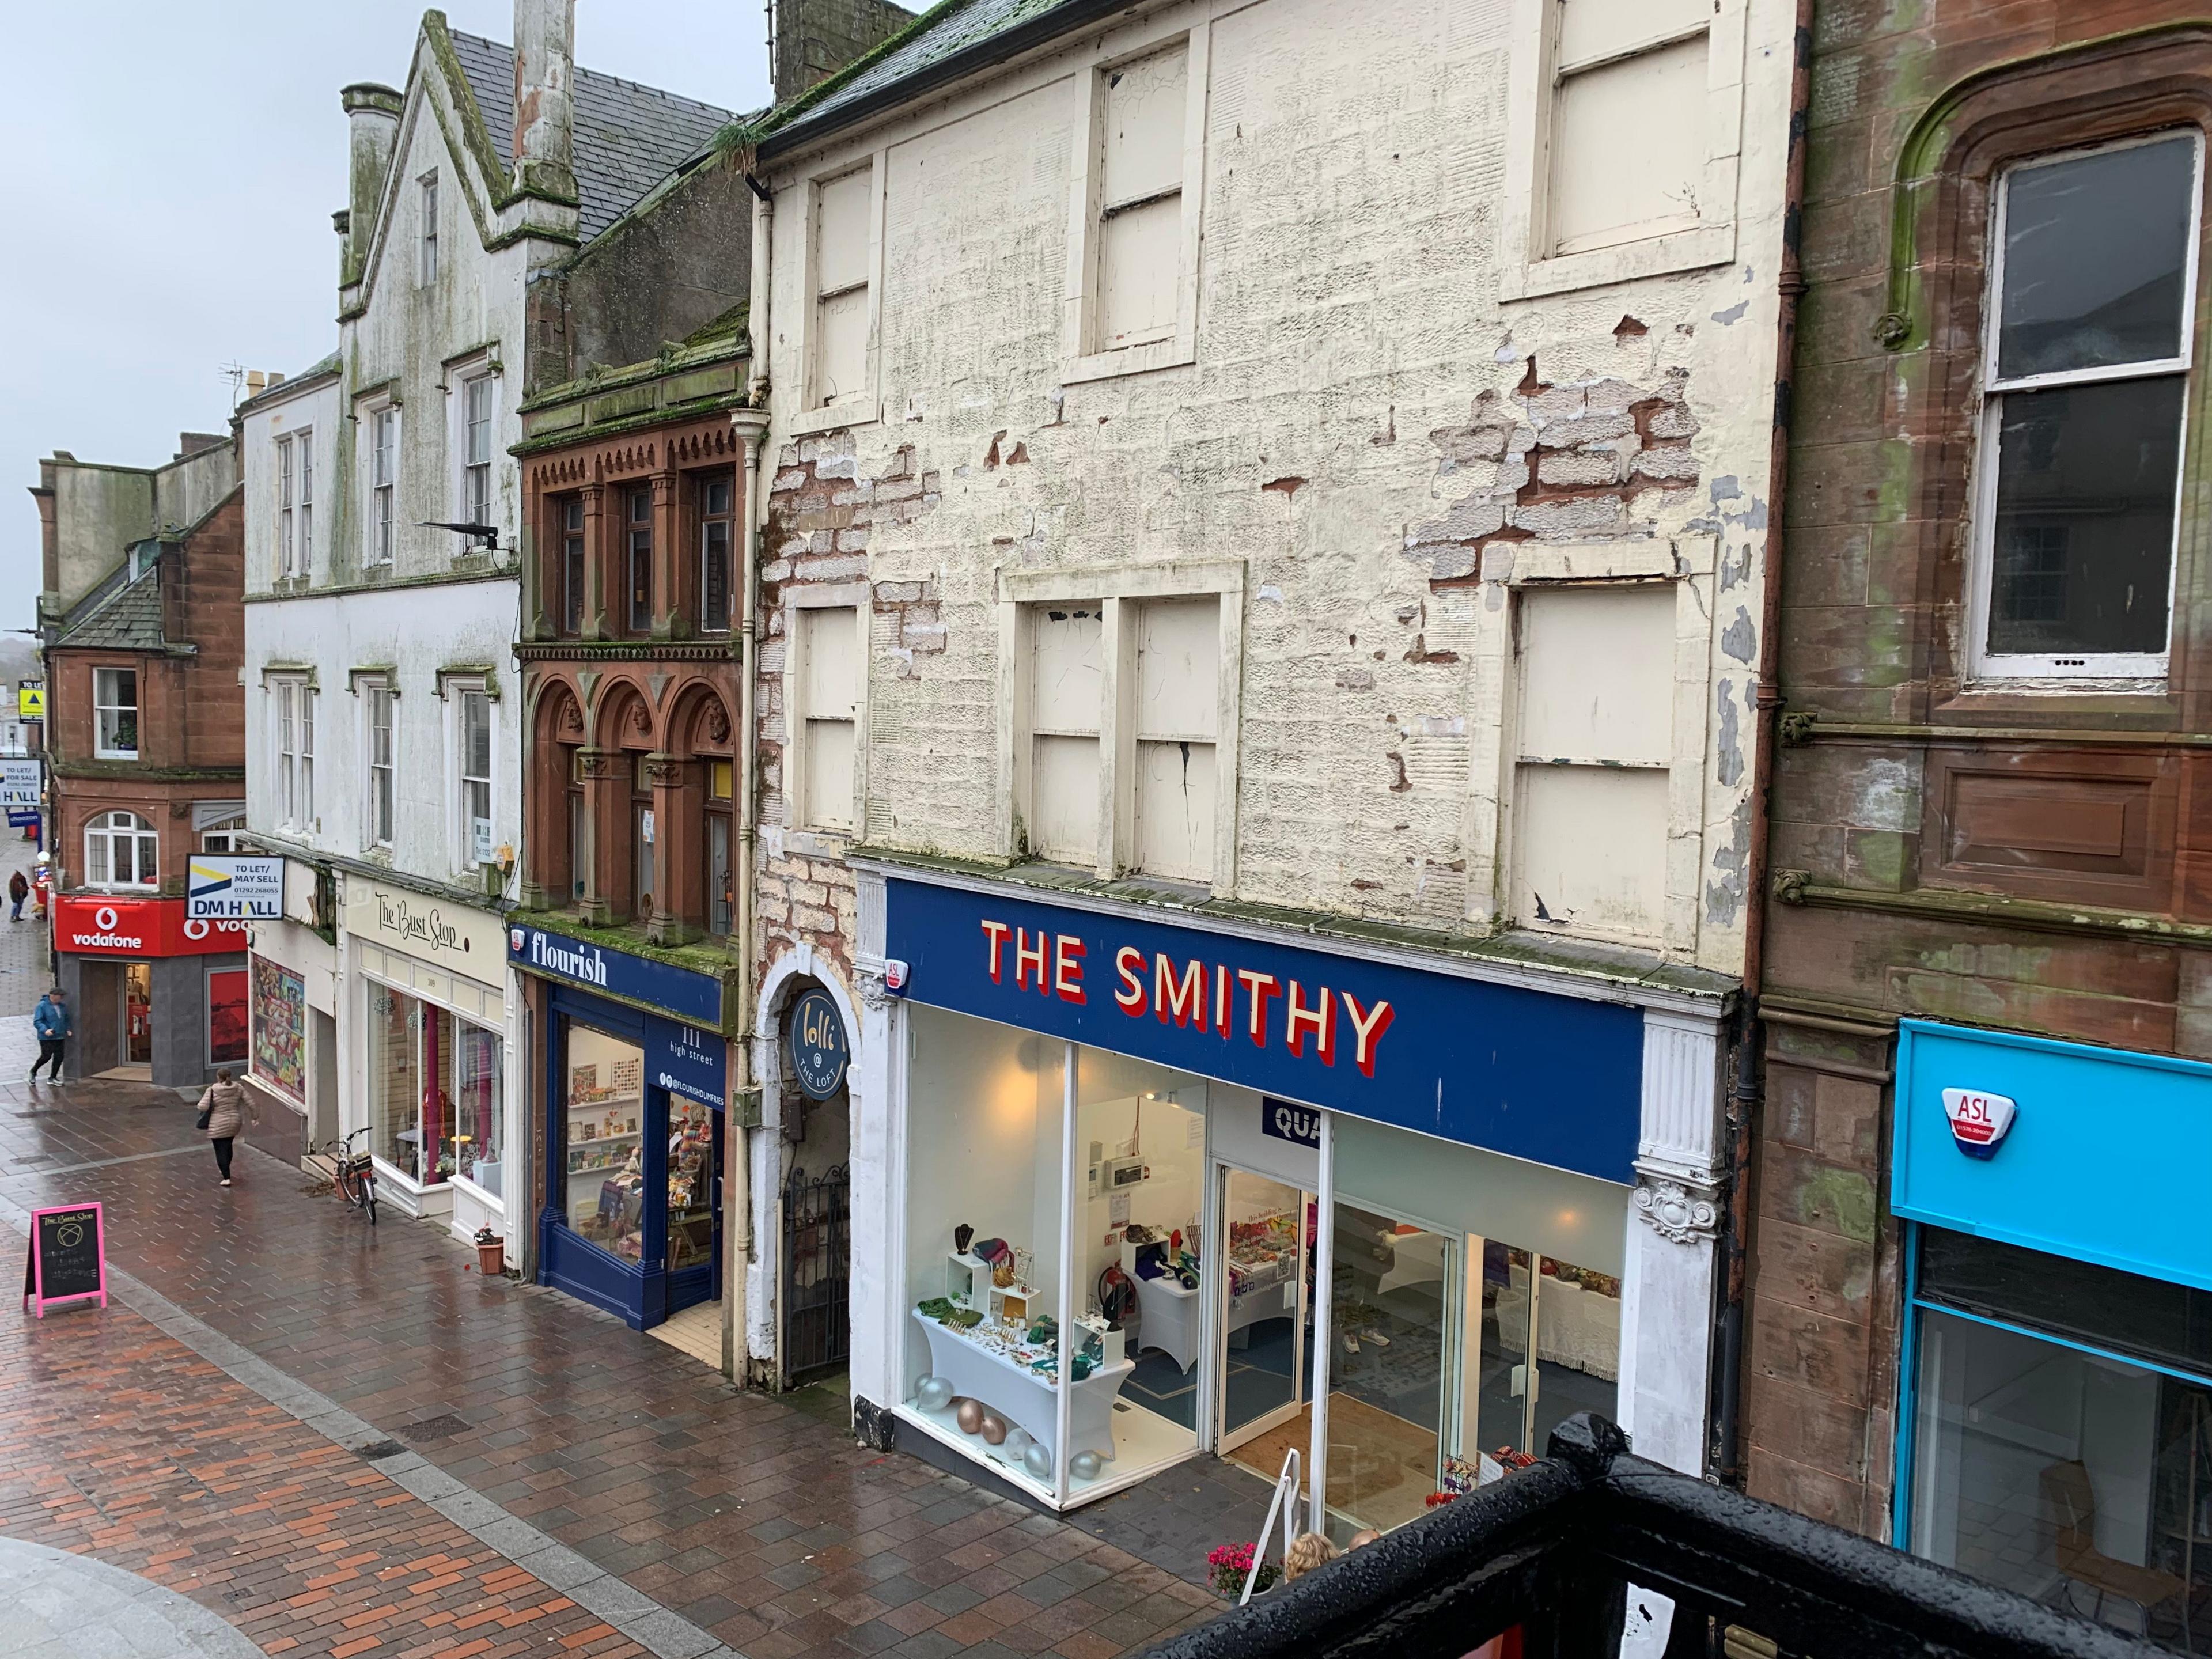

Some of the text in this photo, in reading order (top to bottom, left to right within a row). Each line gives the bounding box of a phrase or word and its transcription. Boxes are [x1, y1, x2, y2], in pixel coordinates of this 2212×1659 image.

[249, 865, 270, 873] LET/
[194, 900, 278, 916] DM HALL
[375, 891, 456, 950] The Bust Stop
[73, 932, 142, 948] vodafone
[532, 931, 607, 986] flourish
[889, 963, 899, 976] ASL
[982, 919, 1395, 1078] THE SMITHY
[683, 1026, 700, 1048] 111
[804, 1002, 834, 1051] lolli
[670, 1041, 713, 1066] high street
[813, 1052, 822, 1068] @
[800, 1058, 836, 1088] THE LOFT
[672, 1079, 724, 1106] @FLOURISHDUMFRIES
[1957, 1096, 1992, 1123] ASL
[42, 1213, 93, 1226] The Bust Stop
